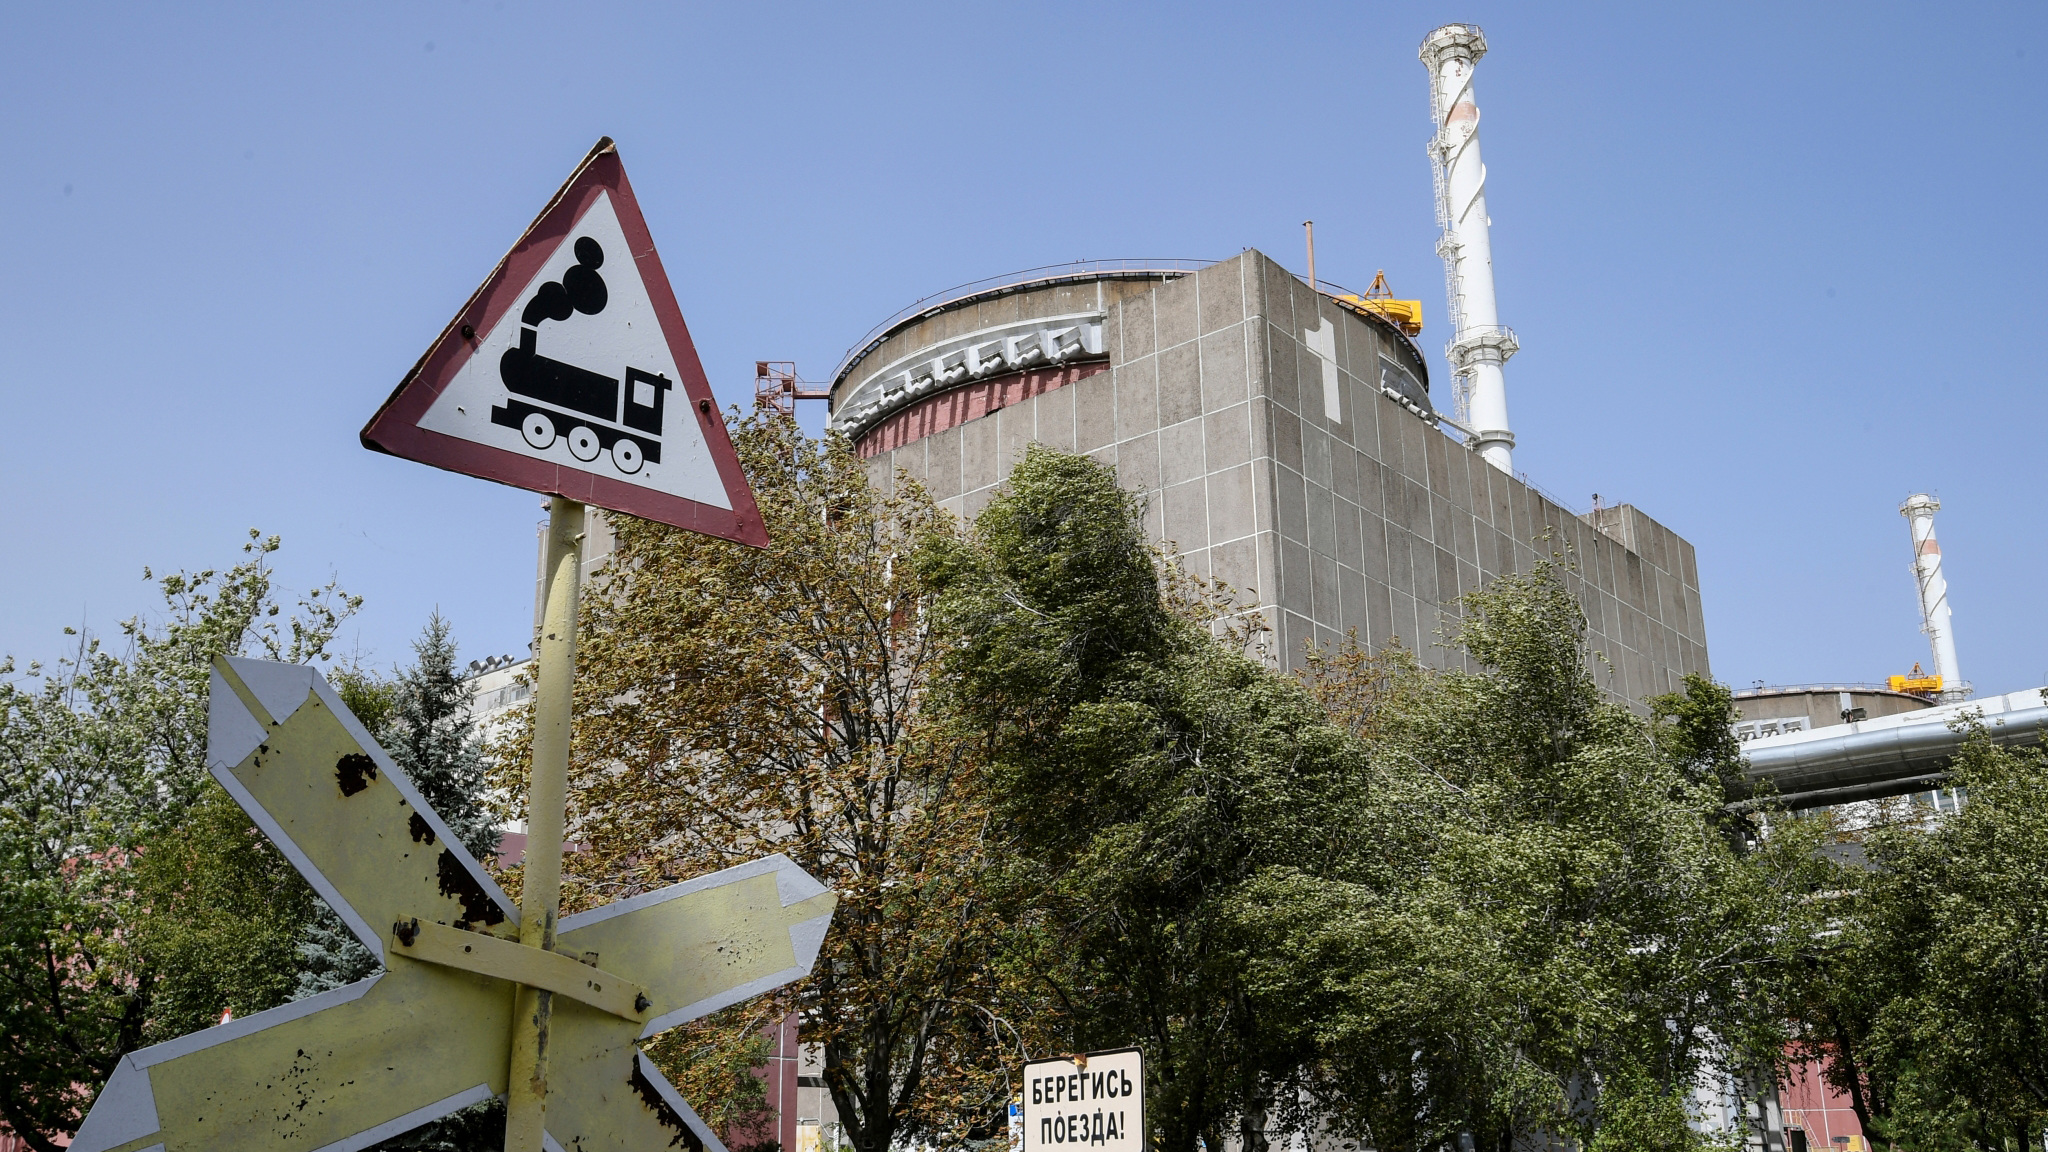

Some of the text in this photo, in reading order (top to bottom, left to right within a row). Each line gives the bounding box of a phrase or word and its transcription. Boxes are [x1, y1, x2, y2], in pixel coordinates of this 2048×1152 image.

[1304, 316, 1342, 425] 1
[1032, 1069, 1133, 1105] БЕРЕГИСЬ
[1041, 1111, 1125, 1147] ПОЕЗДА!
